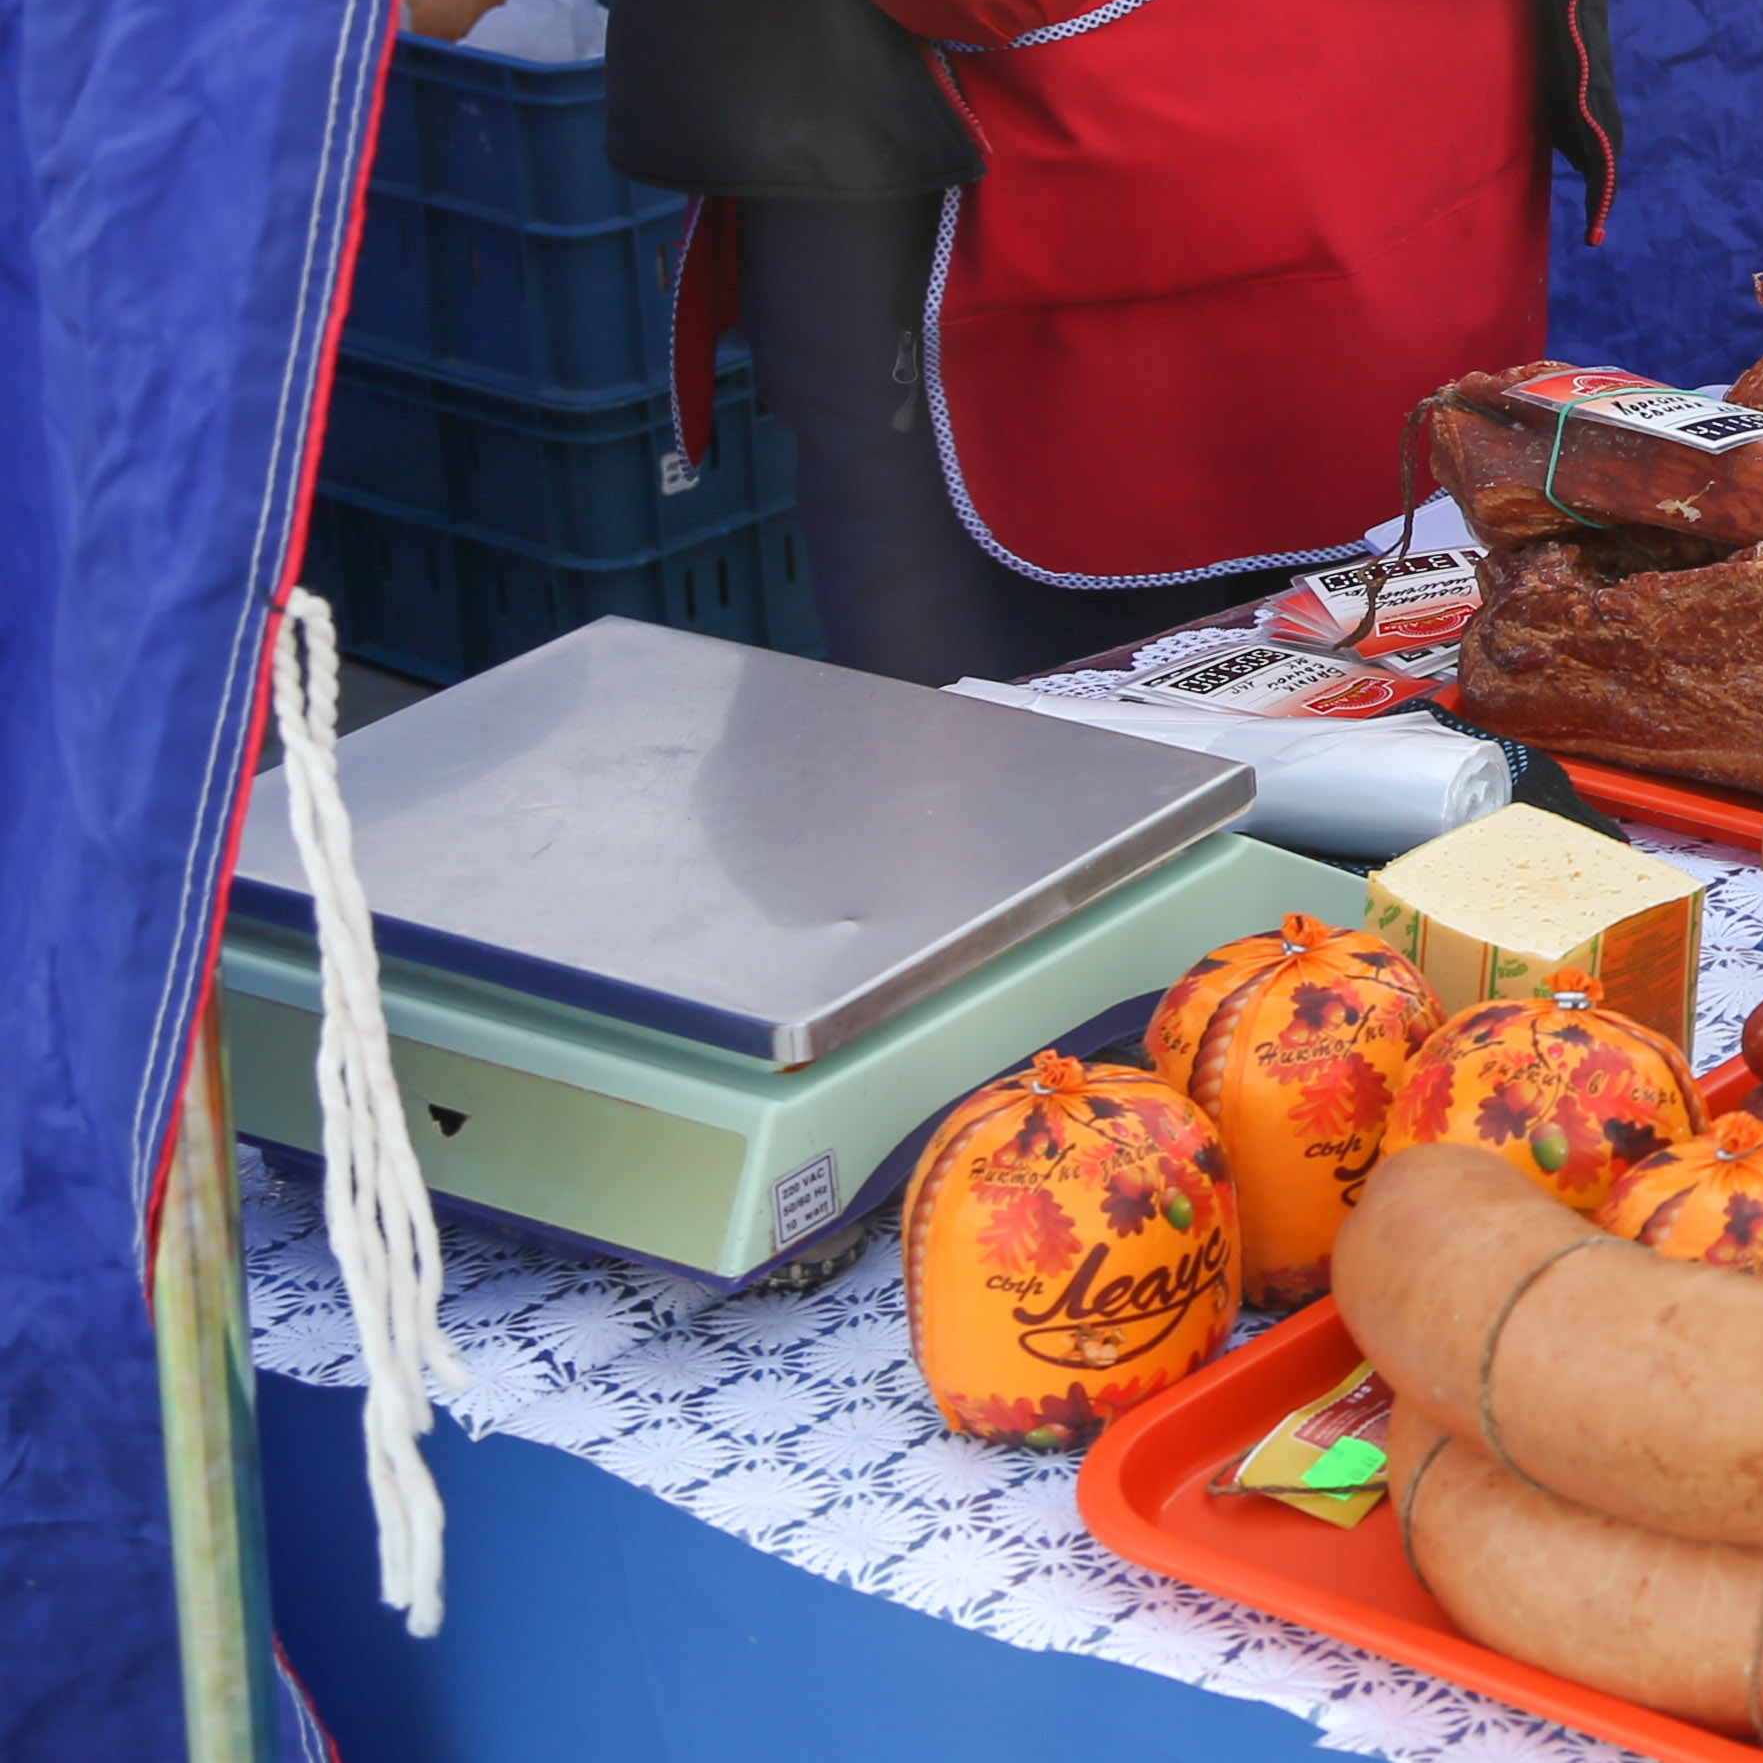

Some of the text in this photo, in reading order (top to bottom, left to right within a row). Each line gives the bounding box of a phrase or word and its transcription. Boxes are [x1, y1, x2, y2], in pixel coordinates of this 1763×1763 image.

[1304, 1134, 1363, 1163] сыр
[782, 1167, 825, 1200] 220 VAC
[786, 1219, 798, 1233] 10
[985, 1273, 1044, 1303] сыр
